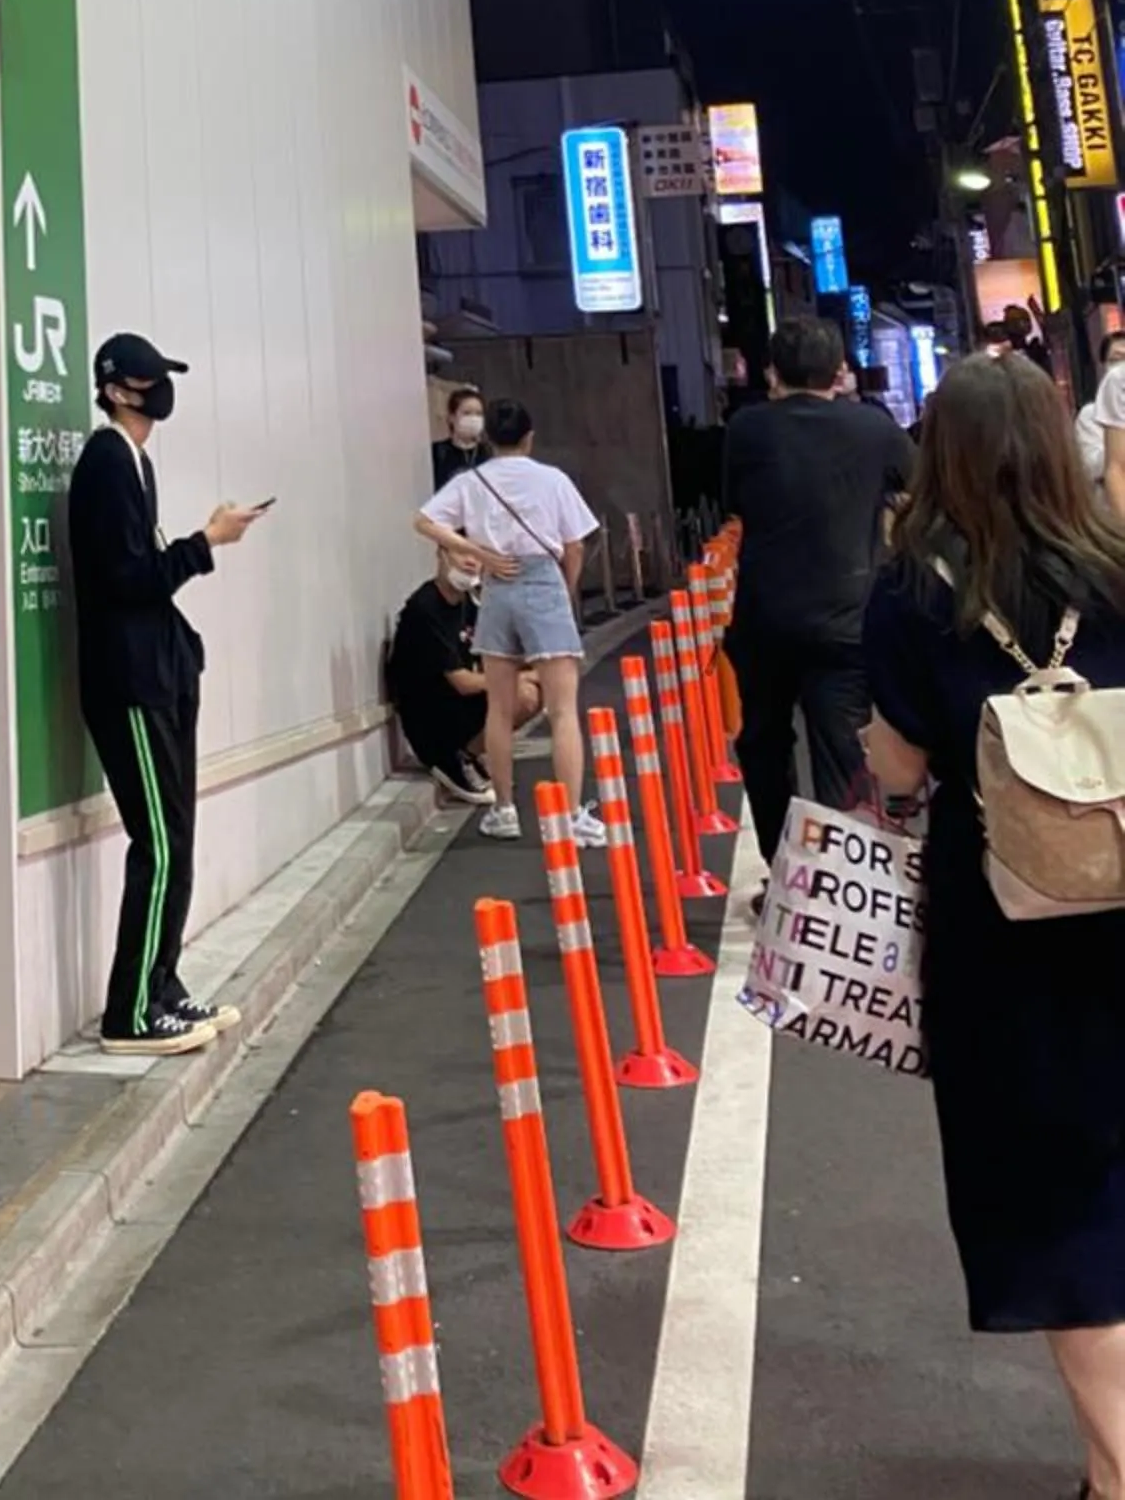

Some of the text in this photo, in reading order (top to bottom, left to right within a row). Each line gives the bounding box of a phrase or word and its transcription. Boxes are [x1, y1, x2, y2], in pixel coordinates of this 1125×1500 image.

[1072, 32, 1108, 151] TC GAKKI
[583, 149, 613, 252] 新宿歯科
[13, 295, 68, 376] JR
[20, 517, 51, 555] 入口
[819, 822, 892, 877] FOR
[819, 968, 922, 1029] TREA
[782, 1011, 932, 1079] ARMAD
